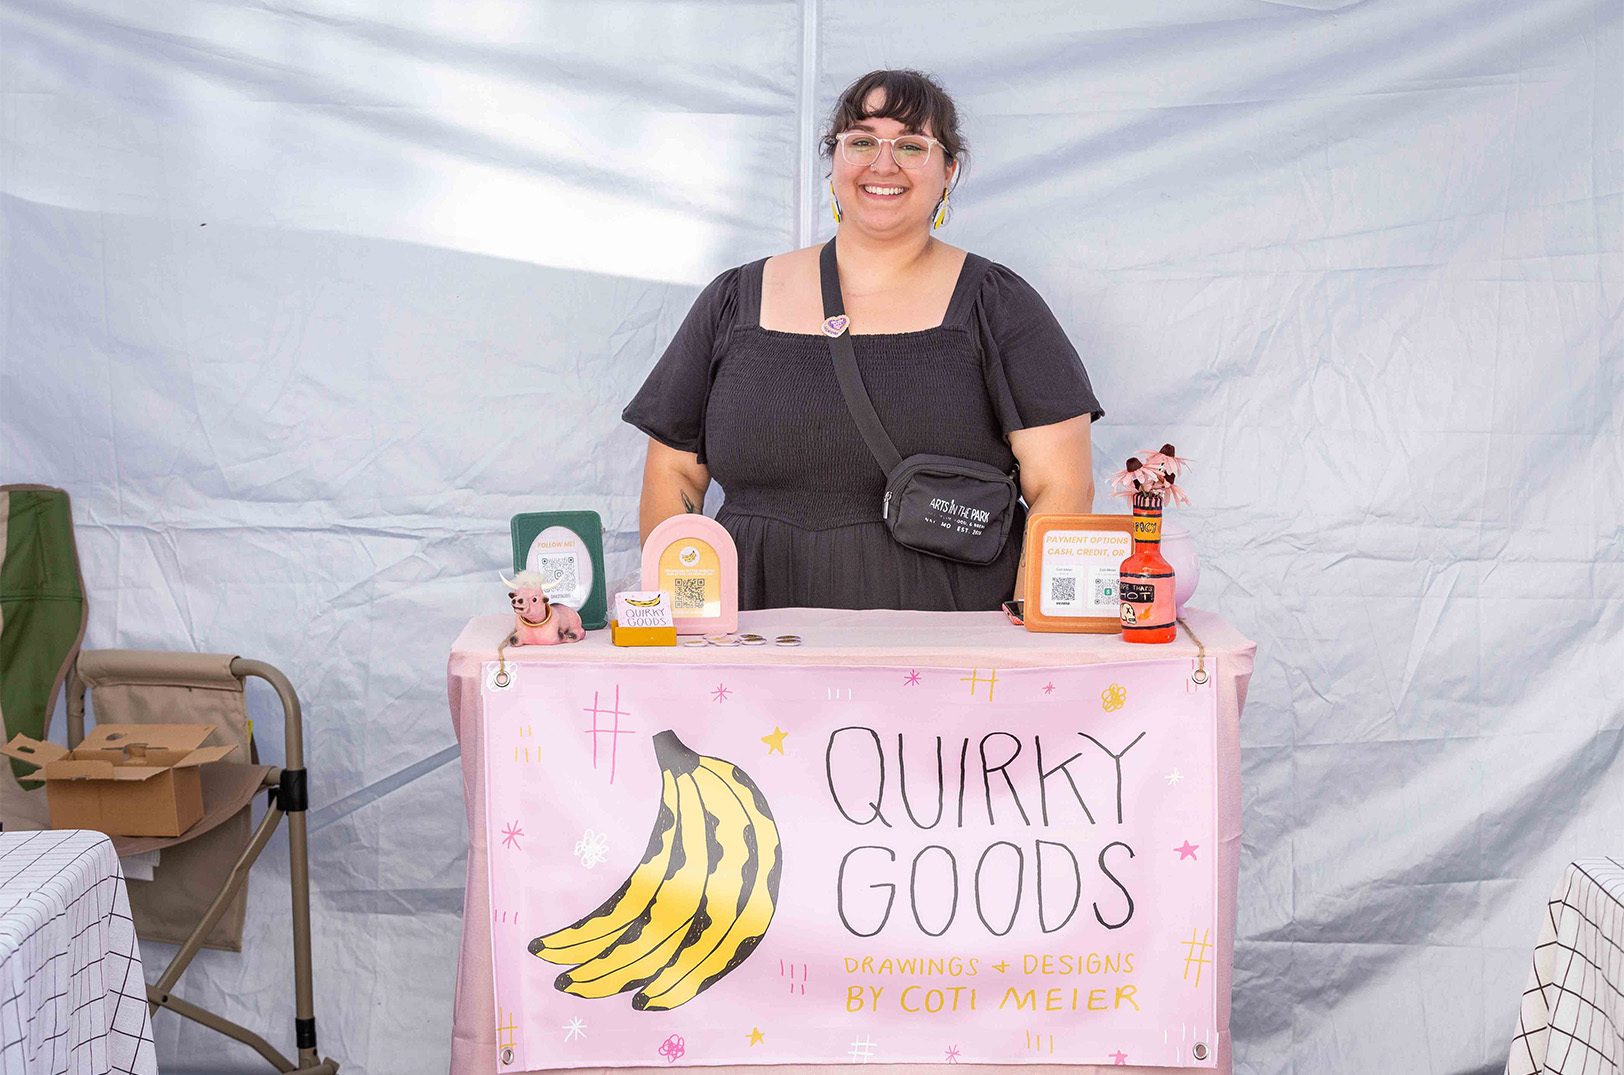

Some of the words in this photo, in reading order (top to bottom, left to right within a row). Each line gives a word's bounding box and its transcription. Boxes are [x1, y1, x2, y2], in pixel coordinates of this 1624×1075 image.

[928, 497, 950, 513] ARTS
[948, 499, 958, 515] IN
[957, 505, 971, 519] THE
[970, 508, 991, 523] PARK
[1132, 522, 1157, 533] PICY
[1046, 536, 1088, 544] PAYMENT
[1089, 537, 1129, 545] OPTIONS
[1047, 548, 1074, 556] CASH,
[1076, 548, 1110, 557] CREDIT,
[1111, 549, 1125, 557] OR
[625, 608, 665, 617] QUIRKY
[627, 617, 667, 627] GOODS
[825, 726, 1147, 830] QUIRKY
[837, 838, 1136, 938] GOODS
[843, 955, 980, 977] DRAWINGS
[1022, 952, 1135, 976] DESIGNS
[846, 985, 885, 1013] BY
[900, 985, 977, 1014] COTI
[999, 984, 1141, 1013] MEIER
